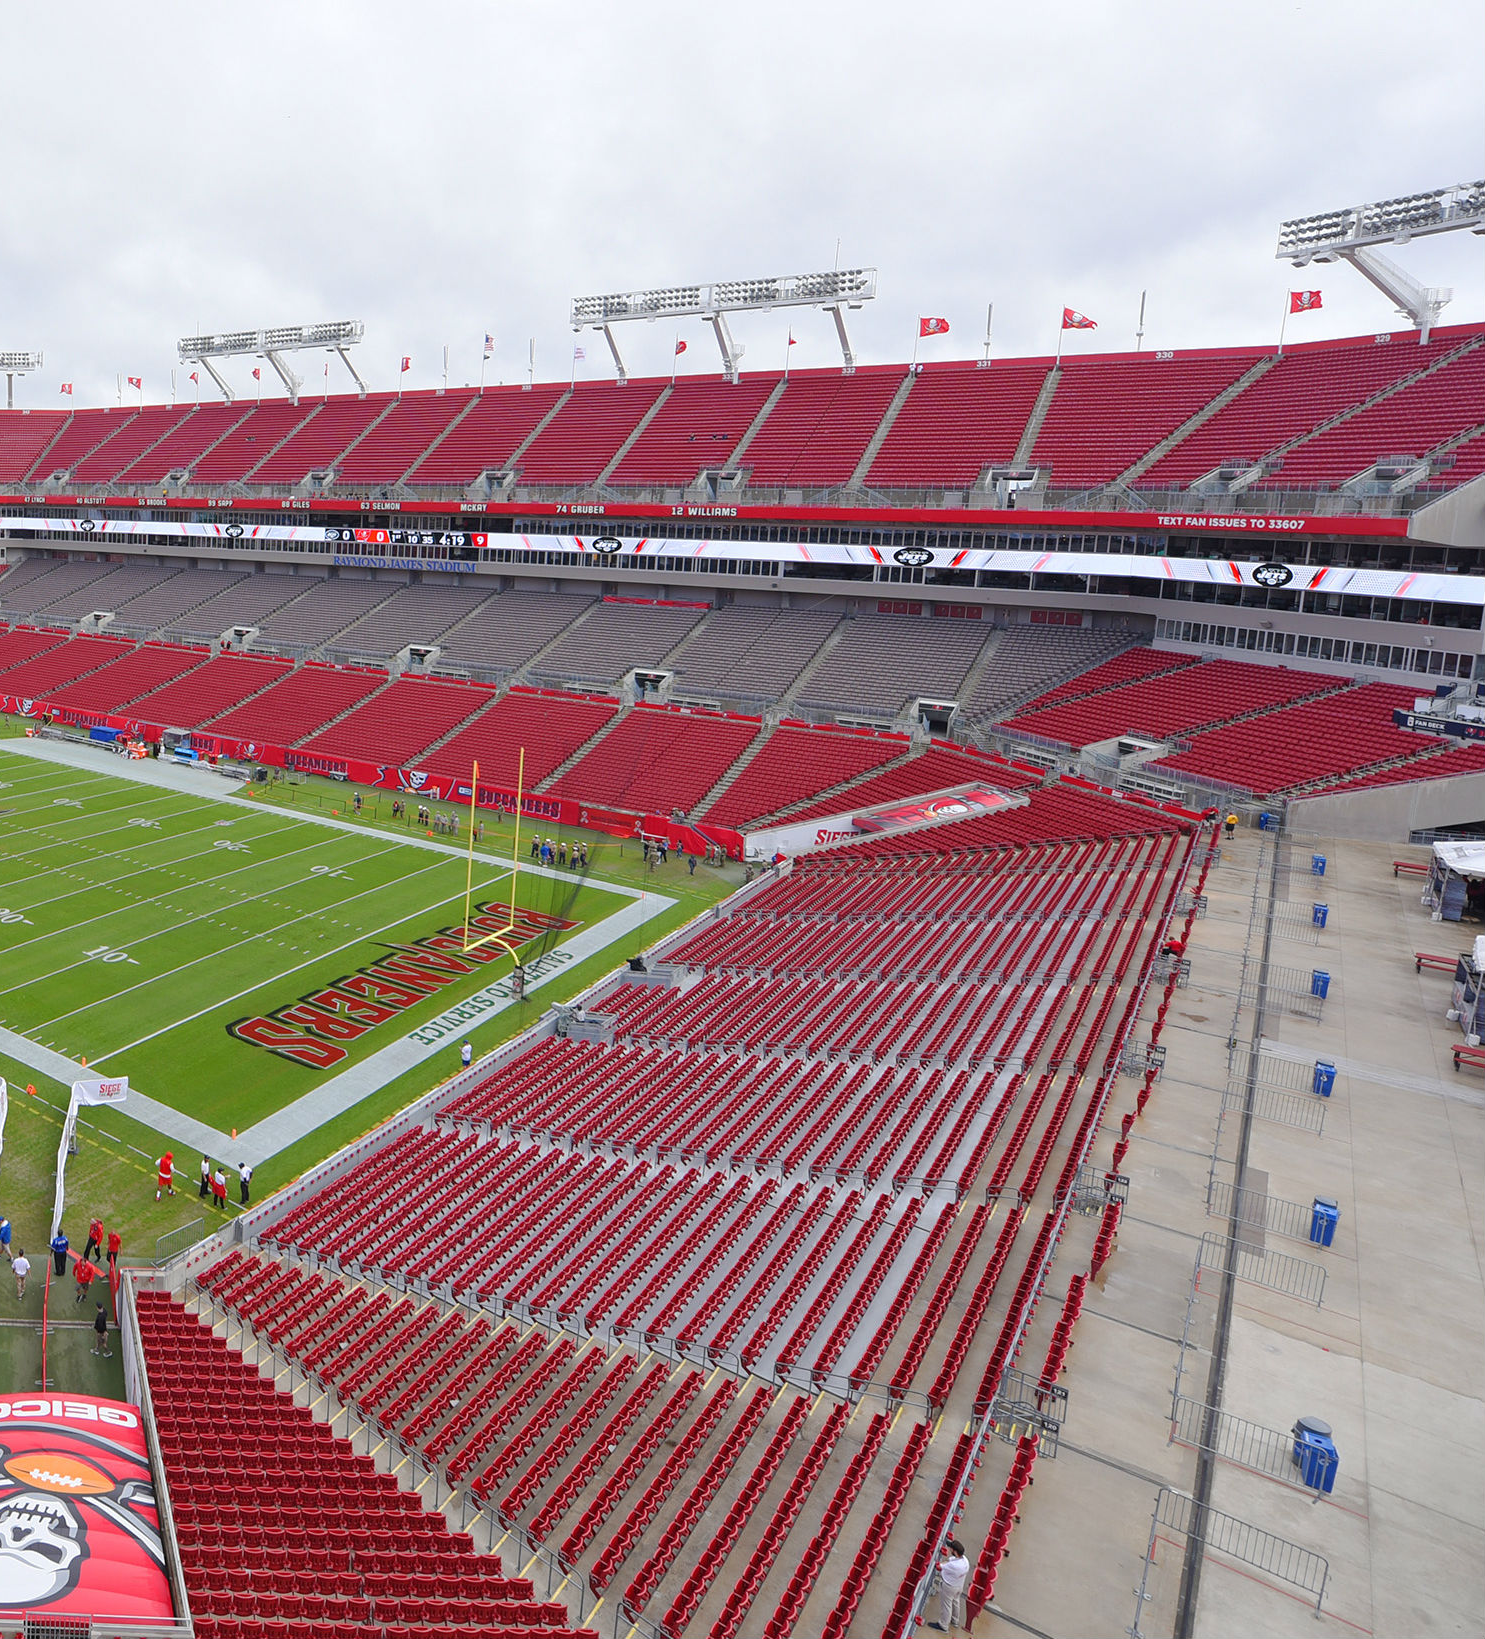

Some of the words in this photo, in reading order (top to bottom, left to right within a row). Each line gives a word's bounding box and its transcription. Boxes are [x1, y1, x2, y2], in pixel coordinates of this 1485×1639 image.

[1374, 334, 1390, 343] 329
[1155, 351, 1174, 359] 330
[976, 360, 991, 368] 331
[292, 501, 310, 509] GILES
[360, 502, 371, 510] 63
[373, 502, 401, 510] SELMON
[556, 505, 567, 514] 74
[571, 505, 605, 515] GRUBER
[671, 507, 684, 516] 12
[688, 507, 737, 517] WILLIAMS
[1157, 516, 1183, 526] TEXT
[1186, 517, 1206, 527] FAN
[1209, 518, 1247, 529] ISSUES
[1249, 519, 1265, 529] TO
[1268, 519, 1305, 530] 33607
[342, 531, 350, 540] 0
[376, 532, 384, 542] 0
[407, 535, 418, 544] 10
[421, 536, 434, 544] 35
[439, 535, 465, 546] 4:19
[476, 536, 485, 545] 9
[333, 556, 386, 568] RAYMOND
[387, 559, 424, 570] JAMES
[425, 560, 476, 573] STADIUM
[1256, 570, 1287, 581] JETS
[1428, 722, 1446, 730] DECK
[478, 787, 562, 820] BUCCANEERS
[82, 946, 128, 963] 10
[226, 901, 585, 1070] BUCCANEERS
[408, 995, 496, 1046] SERVICE
[99, 1083, 122, 1094] SIEGE
[1043, 1421, 1058, 1431] 120
